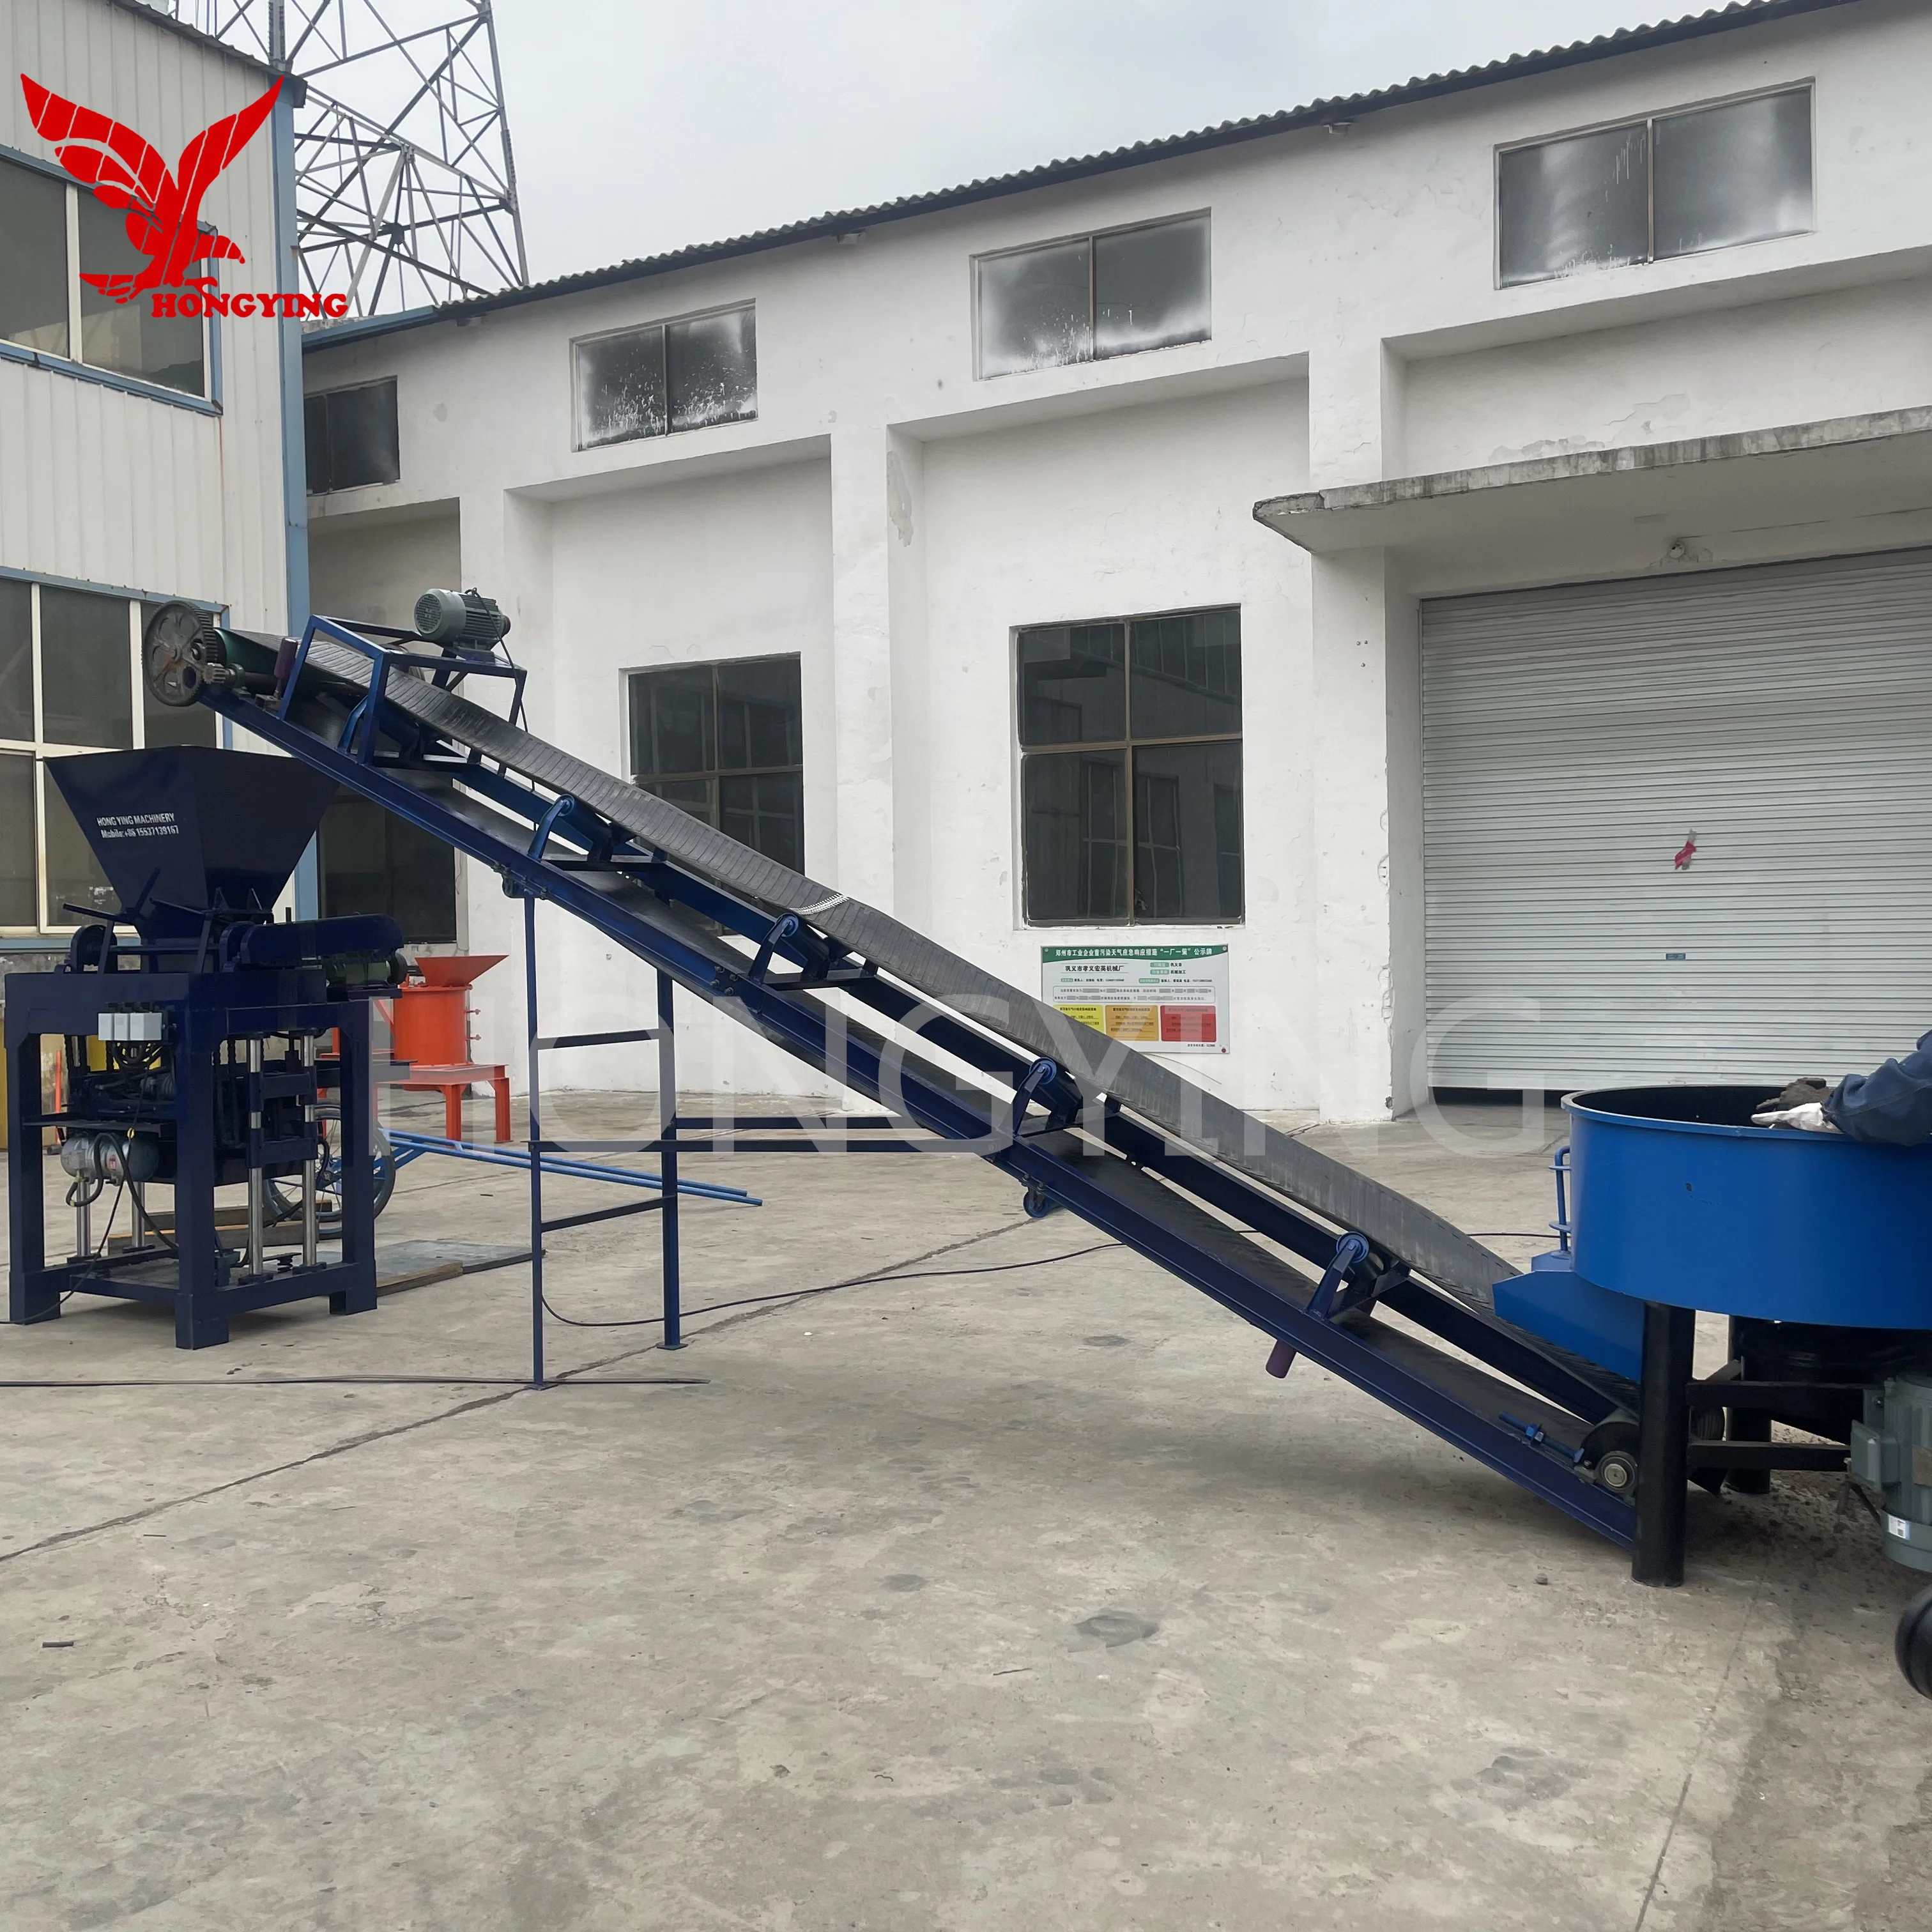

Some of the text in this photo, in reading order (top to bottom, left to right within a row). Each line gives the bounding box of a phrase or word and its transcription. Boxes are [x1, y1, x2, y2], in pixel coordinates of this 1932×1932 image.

[96, 813, 174, 826] HONG YING MACHINERY
[135, 825, 179, 836] 15537139167
